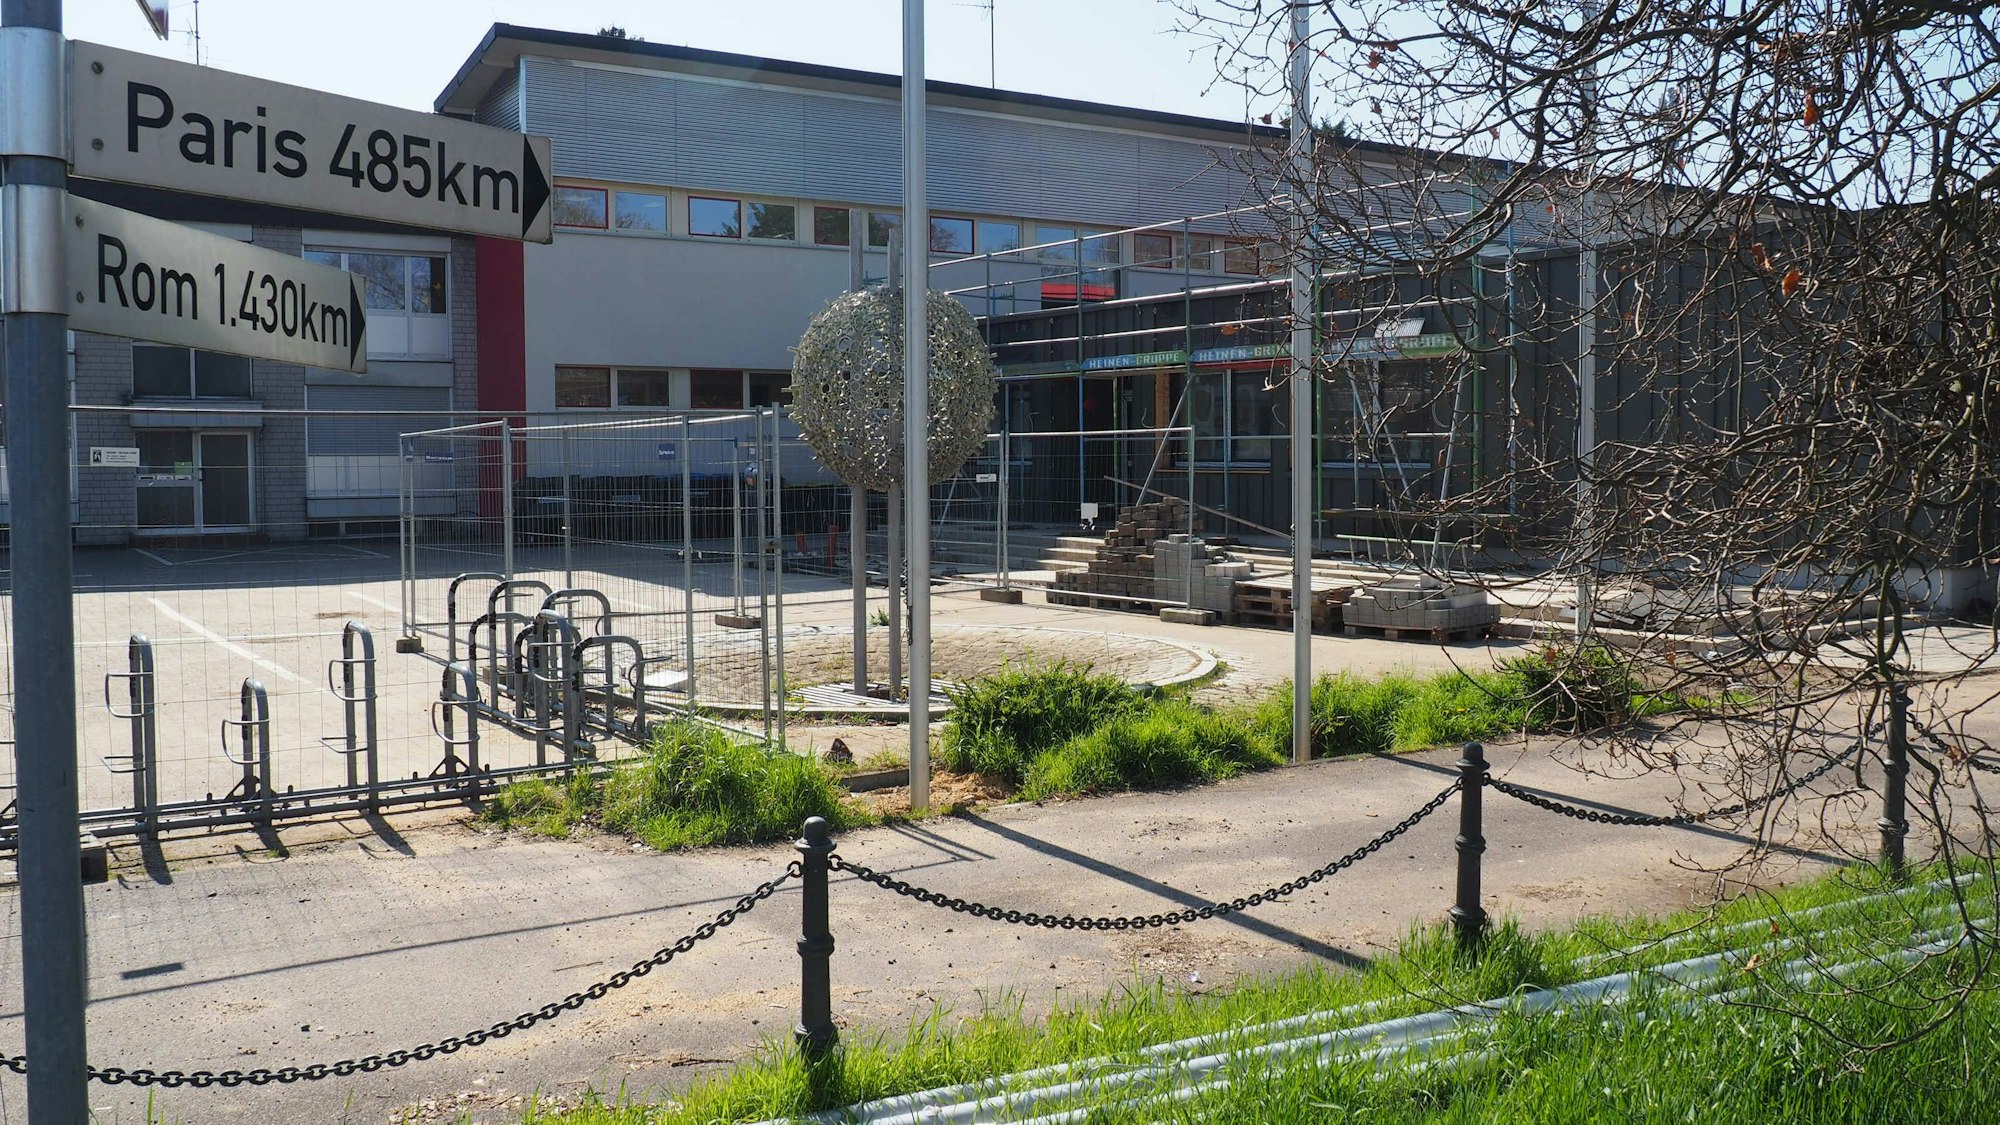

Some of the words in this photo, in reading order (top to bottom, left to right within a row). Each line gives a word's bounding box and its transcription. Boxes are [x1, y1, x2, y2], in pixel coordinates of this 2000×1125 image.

[127, 81, 308, 178] Paris
[329, 123, 519, 214] 485km
[98, 233, 198, 320] Rom
[214, 263, 348, 347] 1.430km
[1089, 352, 1180, 369] HEINEN-GRUPPE
